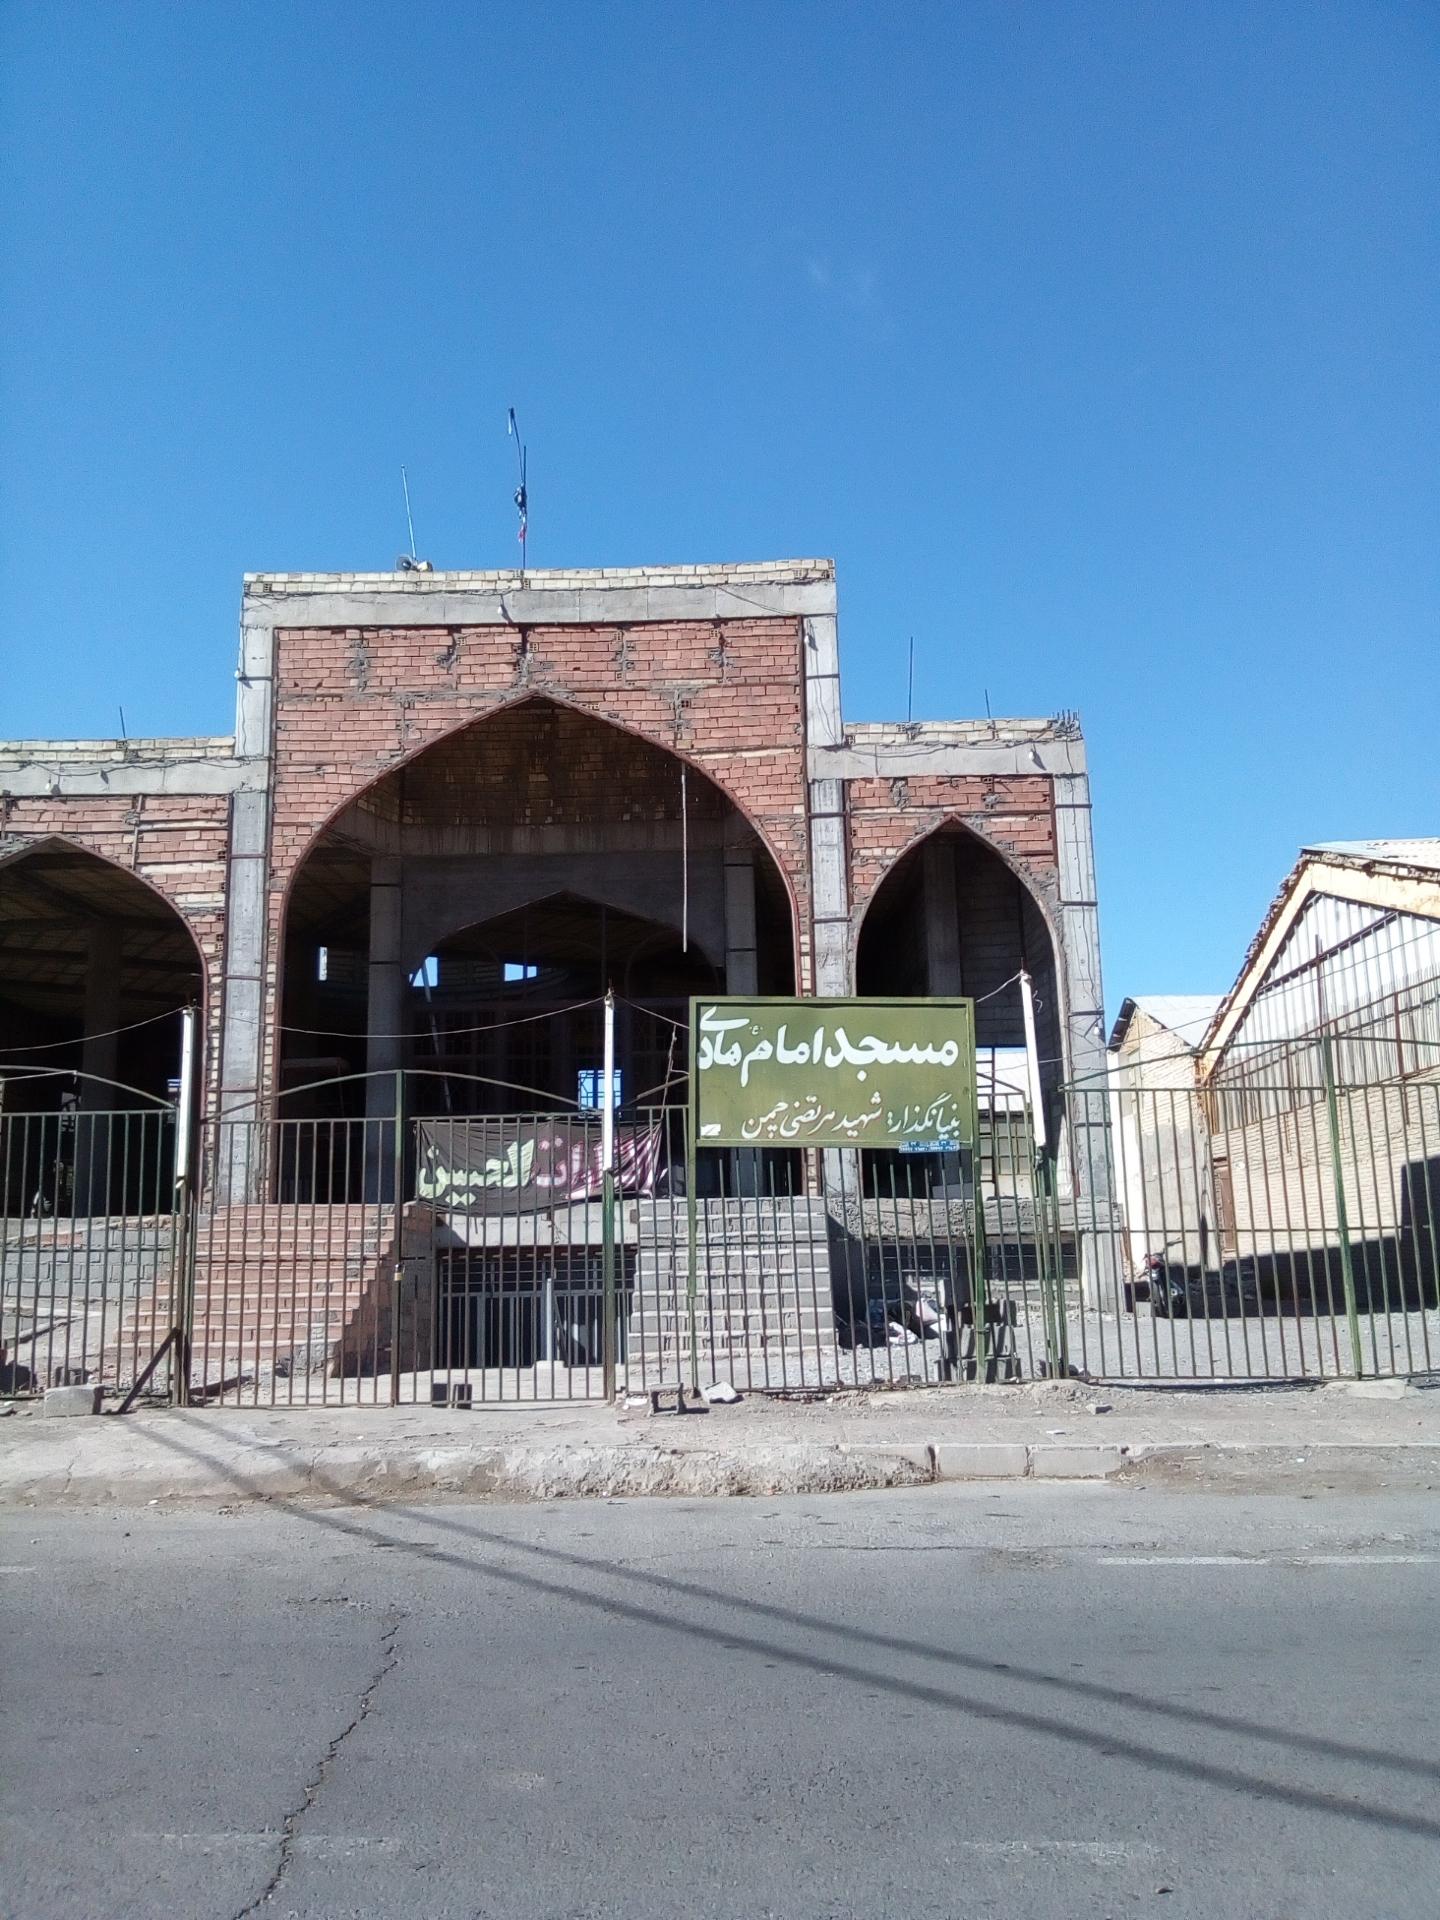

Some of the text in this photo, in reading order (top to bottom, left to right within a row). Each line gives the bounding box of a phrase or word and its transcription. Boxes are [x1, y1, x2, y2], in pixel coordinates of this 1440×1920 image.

[698, 1006, 751, 1070] هادی
[740, 1024, 825, 1087] امام
[824, 1026, 959, 1082] مسجد
[779, 1095, 836, 1138] مرتضی
[831, 1090, 883, 1138] شهید
[418, 1138, 535, 1207] الحسین
